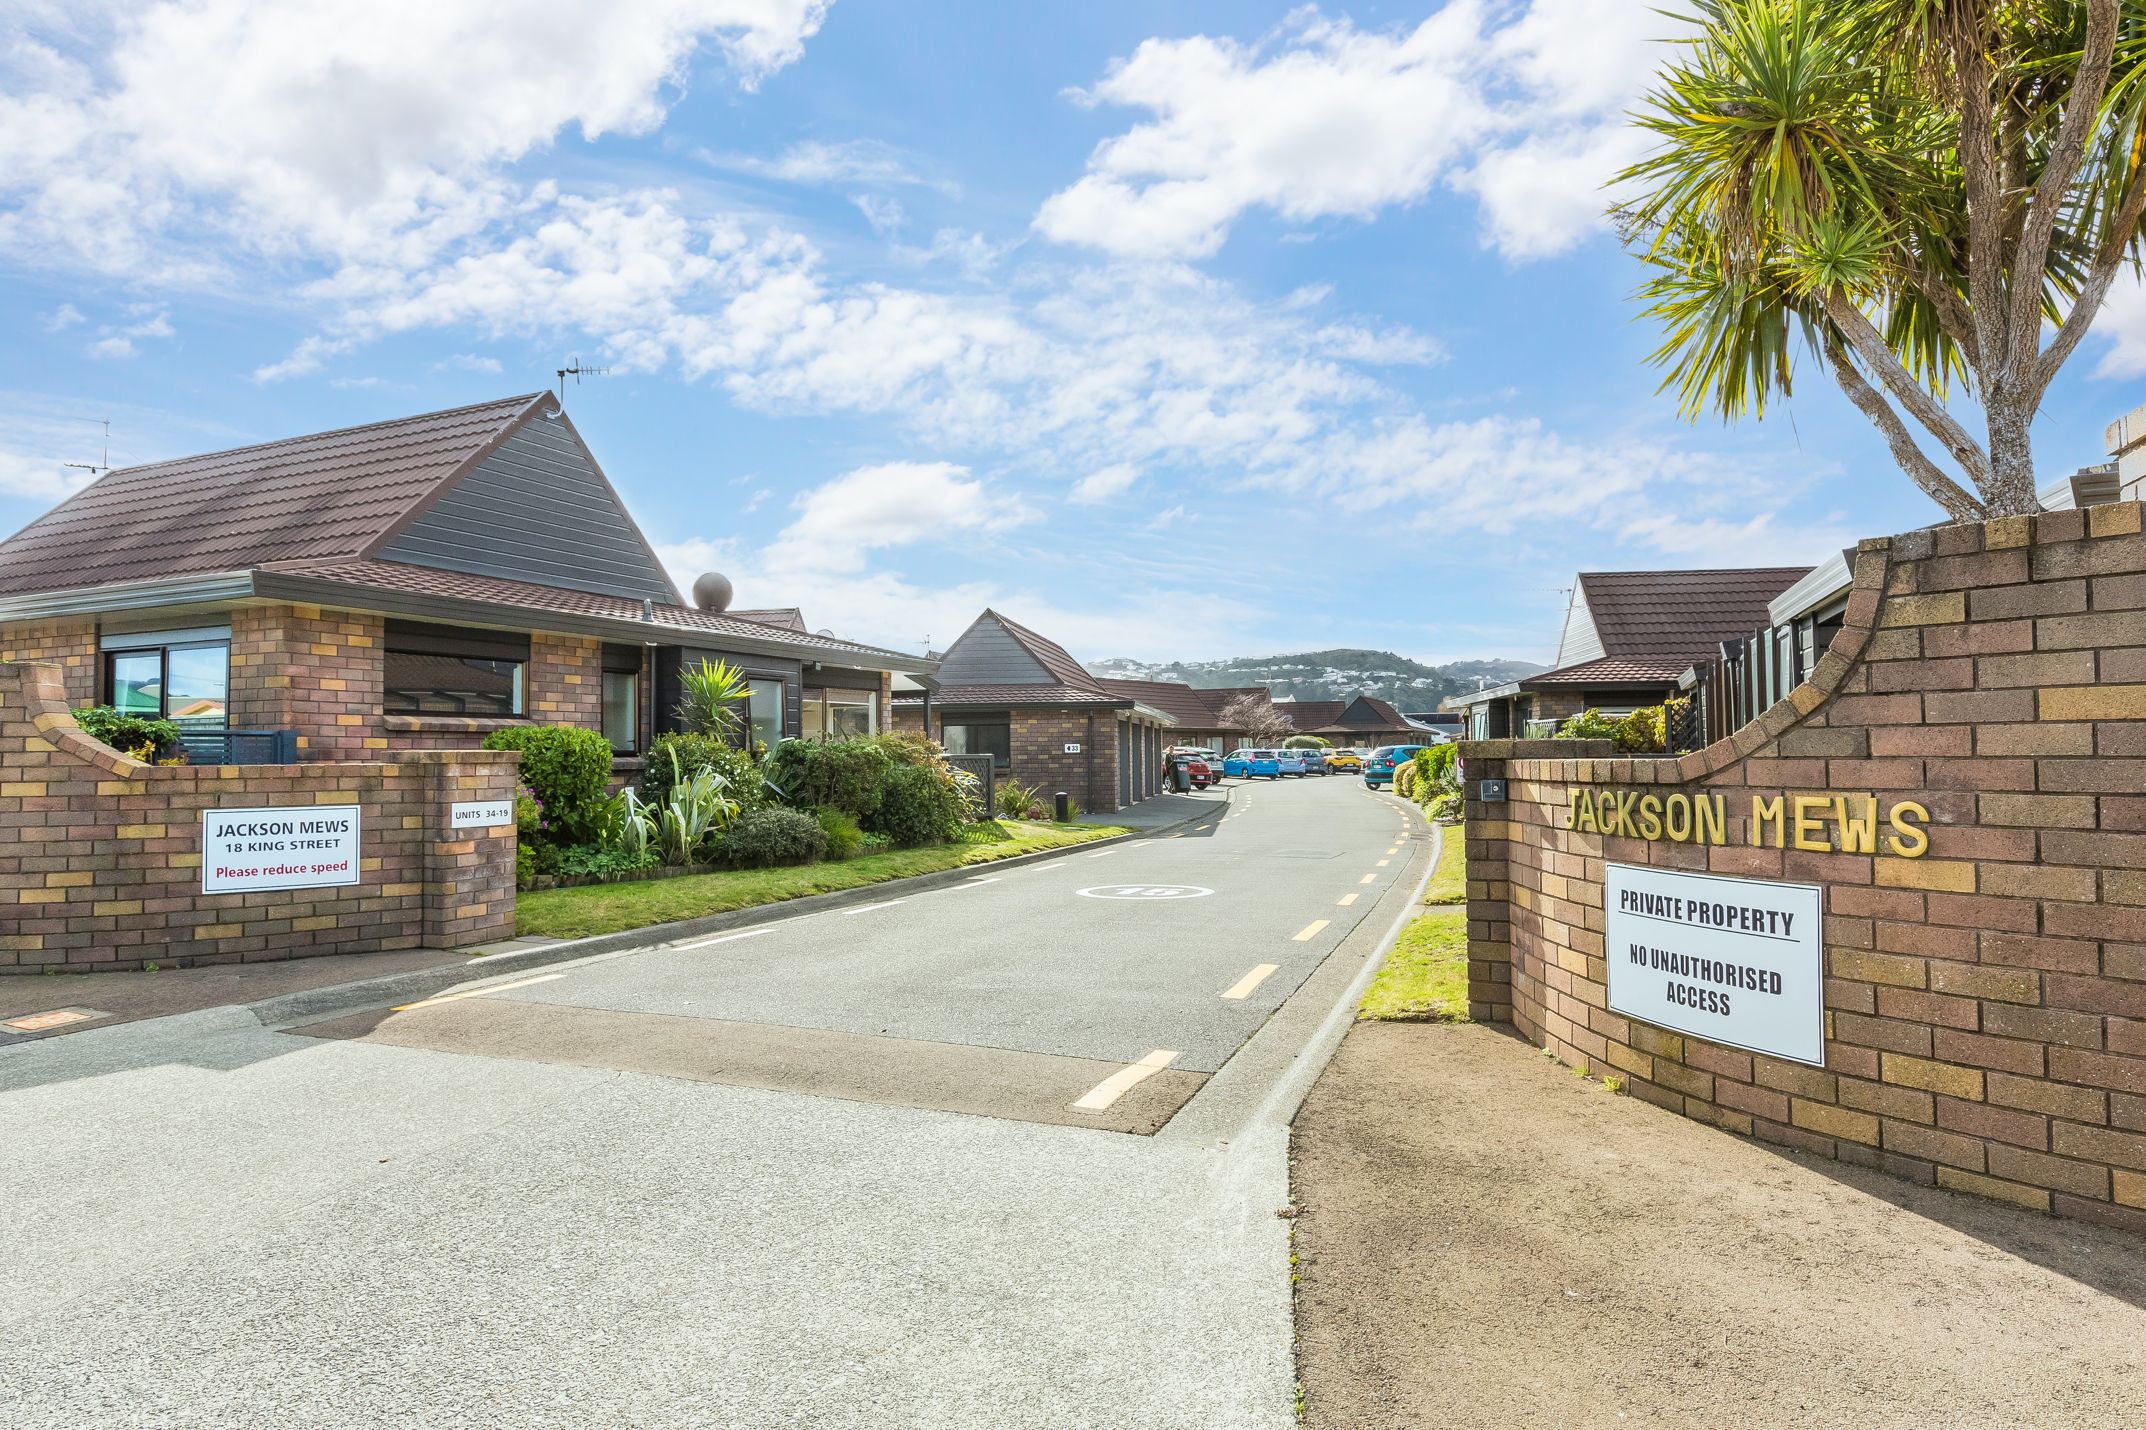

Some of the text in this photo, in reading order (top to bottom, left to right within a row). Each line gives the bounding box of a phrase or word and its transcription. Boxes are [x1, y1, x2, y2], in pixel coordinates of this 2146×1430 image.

[455, 808, 509, 820] UNITS 34-19
[1564, 788, 1931, 858] JACKSON MEWS
[216, 820, 349, 838] JACKSON MEWS
[225, 838, 341, 853] 18 KING STREET
[216, 860, 348, 878] Please reduce speed
[1621, 888, 1794, 936] PRIVATE PROPERTY
[1630, 944, 1782, 996] NO UNAUTHORISED
[1666, 981, 1731, 1017] ACCESS
